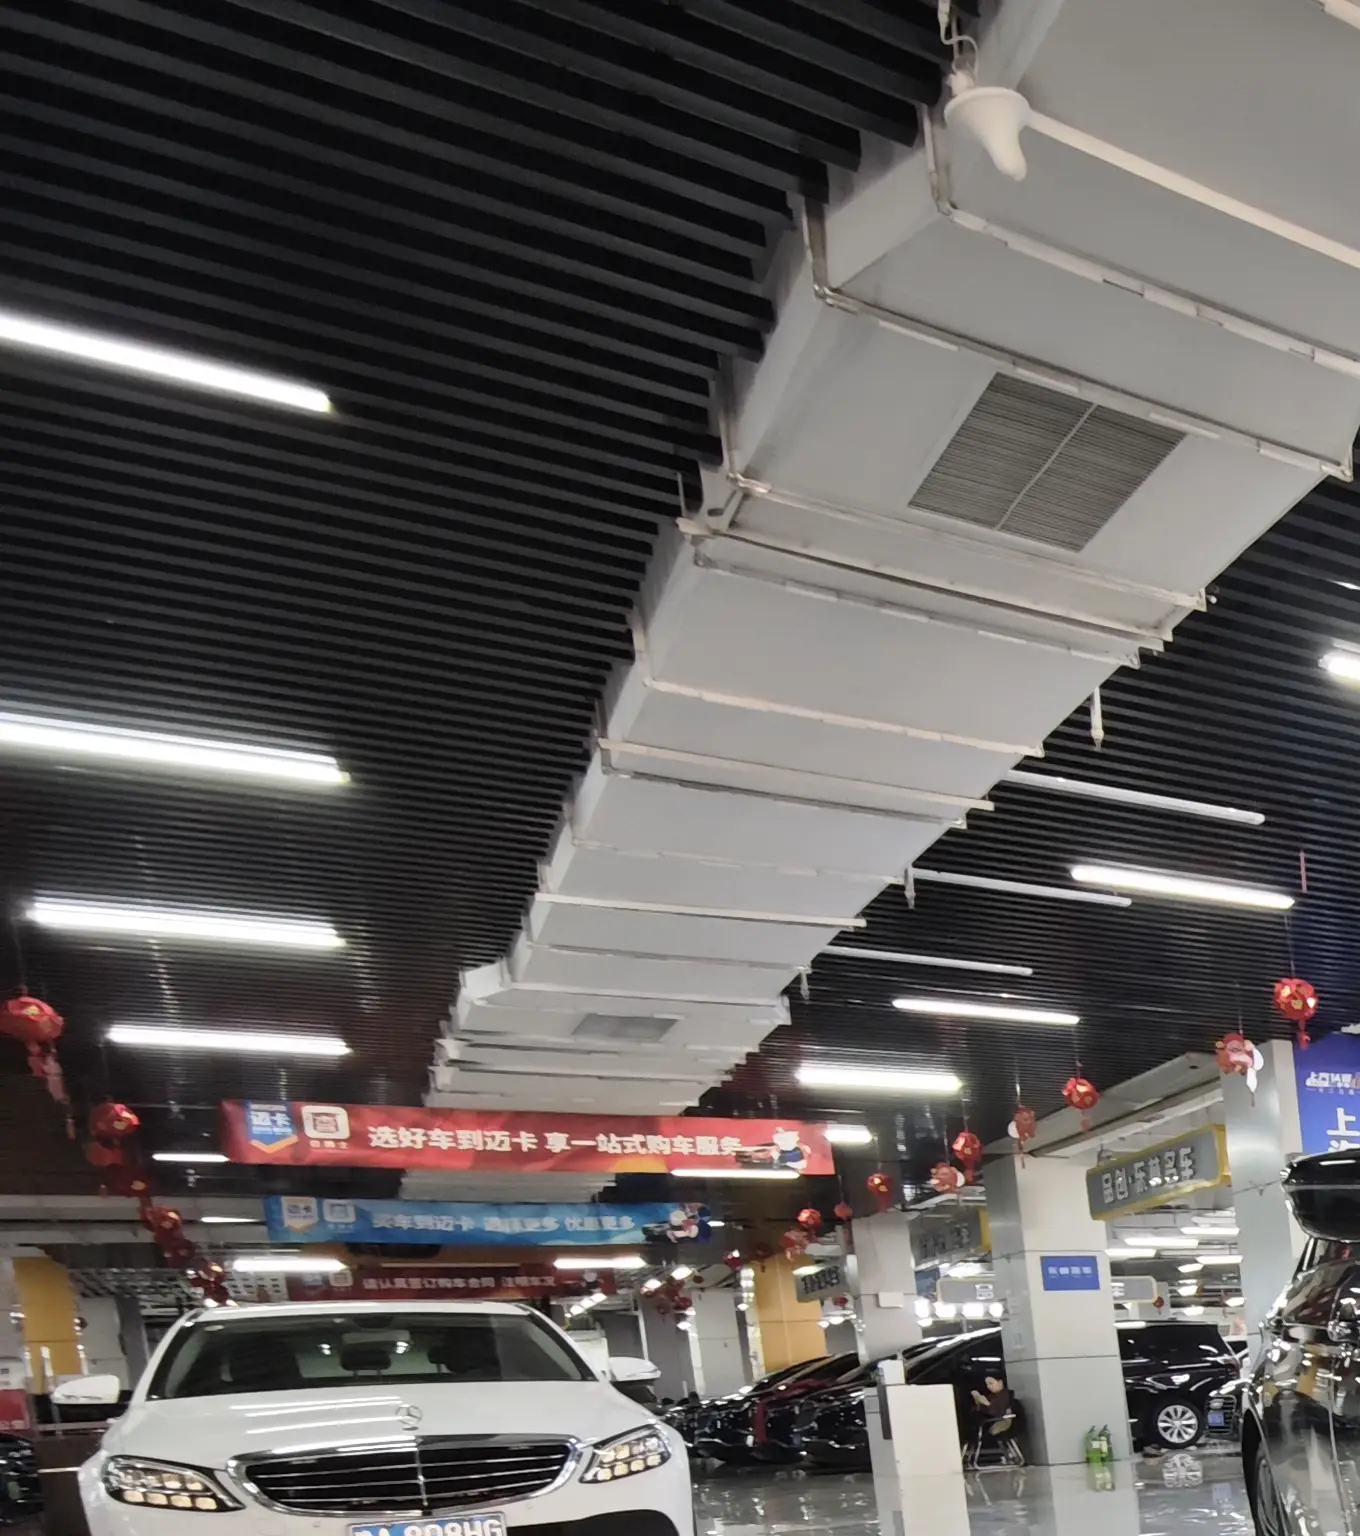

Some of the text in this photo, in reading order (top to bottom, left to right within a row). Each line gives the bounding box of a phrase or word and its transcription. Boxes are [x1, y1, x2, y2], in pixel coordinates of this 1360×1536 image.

[367, 1126, 741, 1156] 选好车到迈卡 享一站式购车服务
